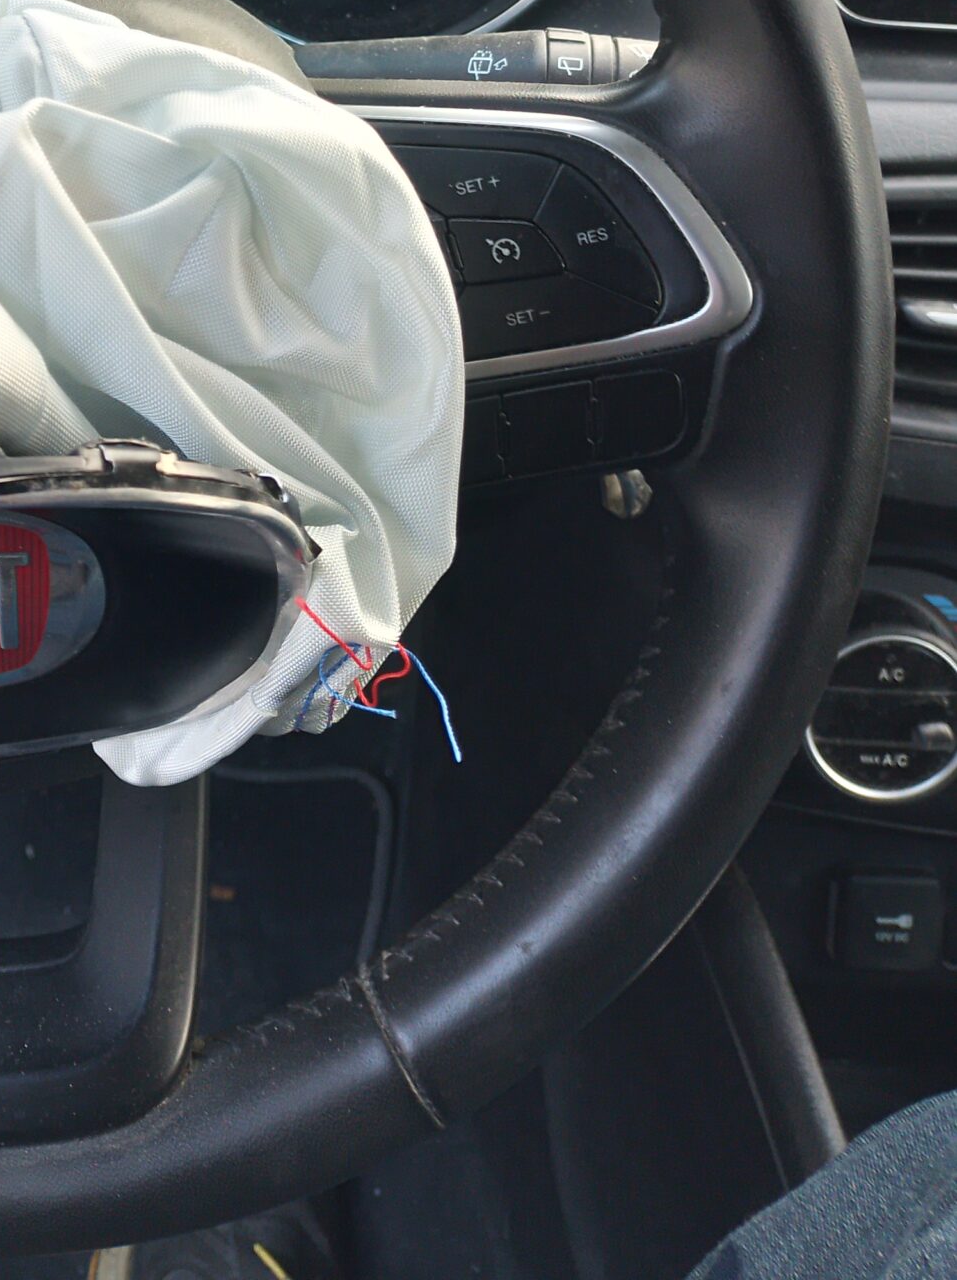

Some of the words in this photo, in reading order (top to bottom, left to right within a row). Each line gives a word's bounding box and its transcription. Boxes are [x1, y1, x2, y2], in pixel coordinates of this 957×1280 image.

[455, 177, 483, 196] SET
[576, 227, 609, 247] RES
[505, 309, 535, 327] SET
